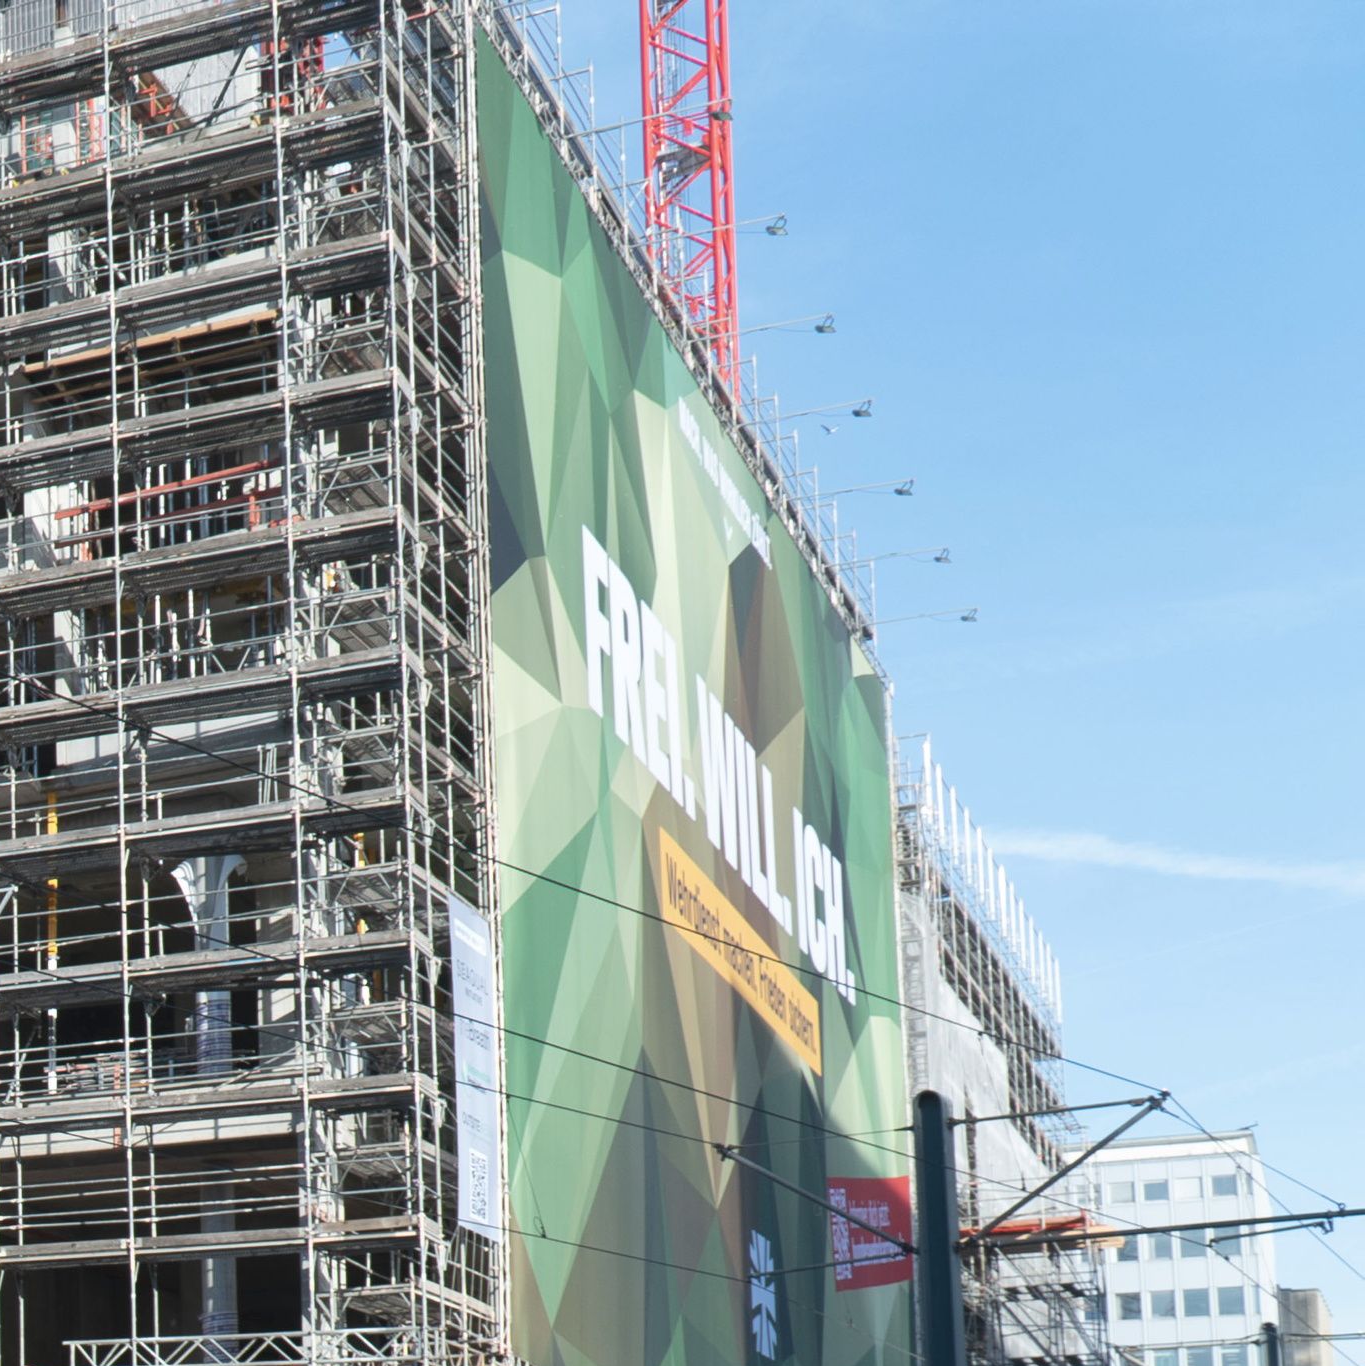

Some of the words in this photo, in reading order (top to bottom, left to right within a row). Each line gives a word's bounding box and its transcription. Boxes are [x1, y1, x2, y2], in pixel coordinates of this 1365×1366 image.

[582, 523, 697, 822] FREI.
[695, 673, 793, 937] WILL.
[792, 806, 856, 1006] ICH.
